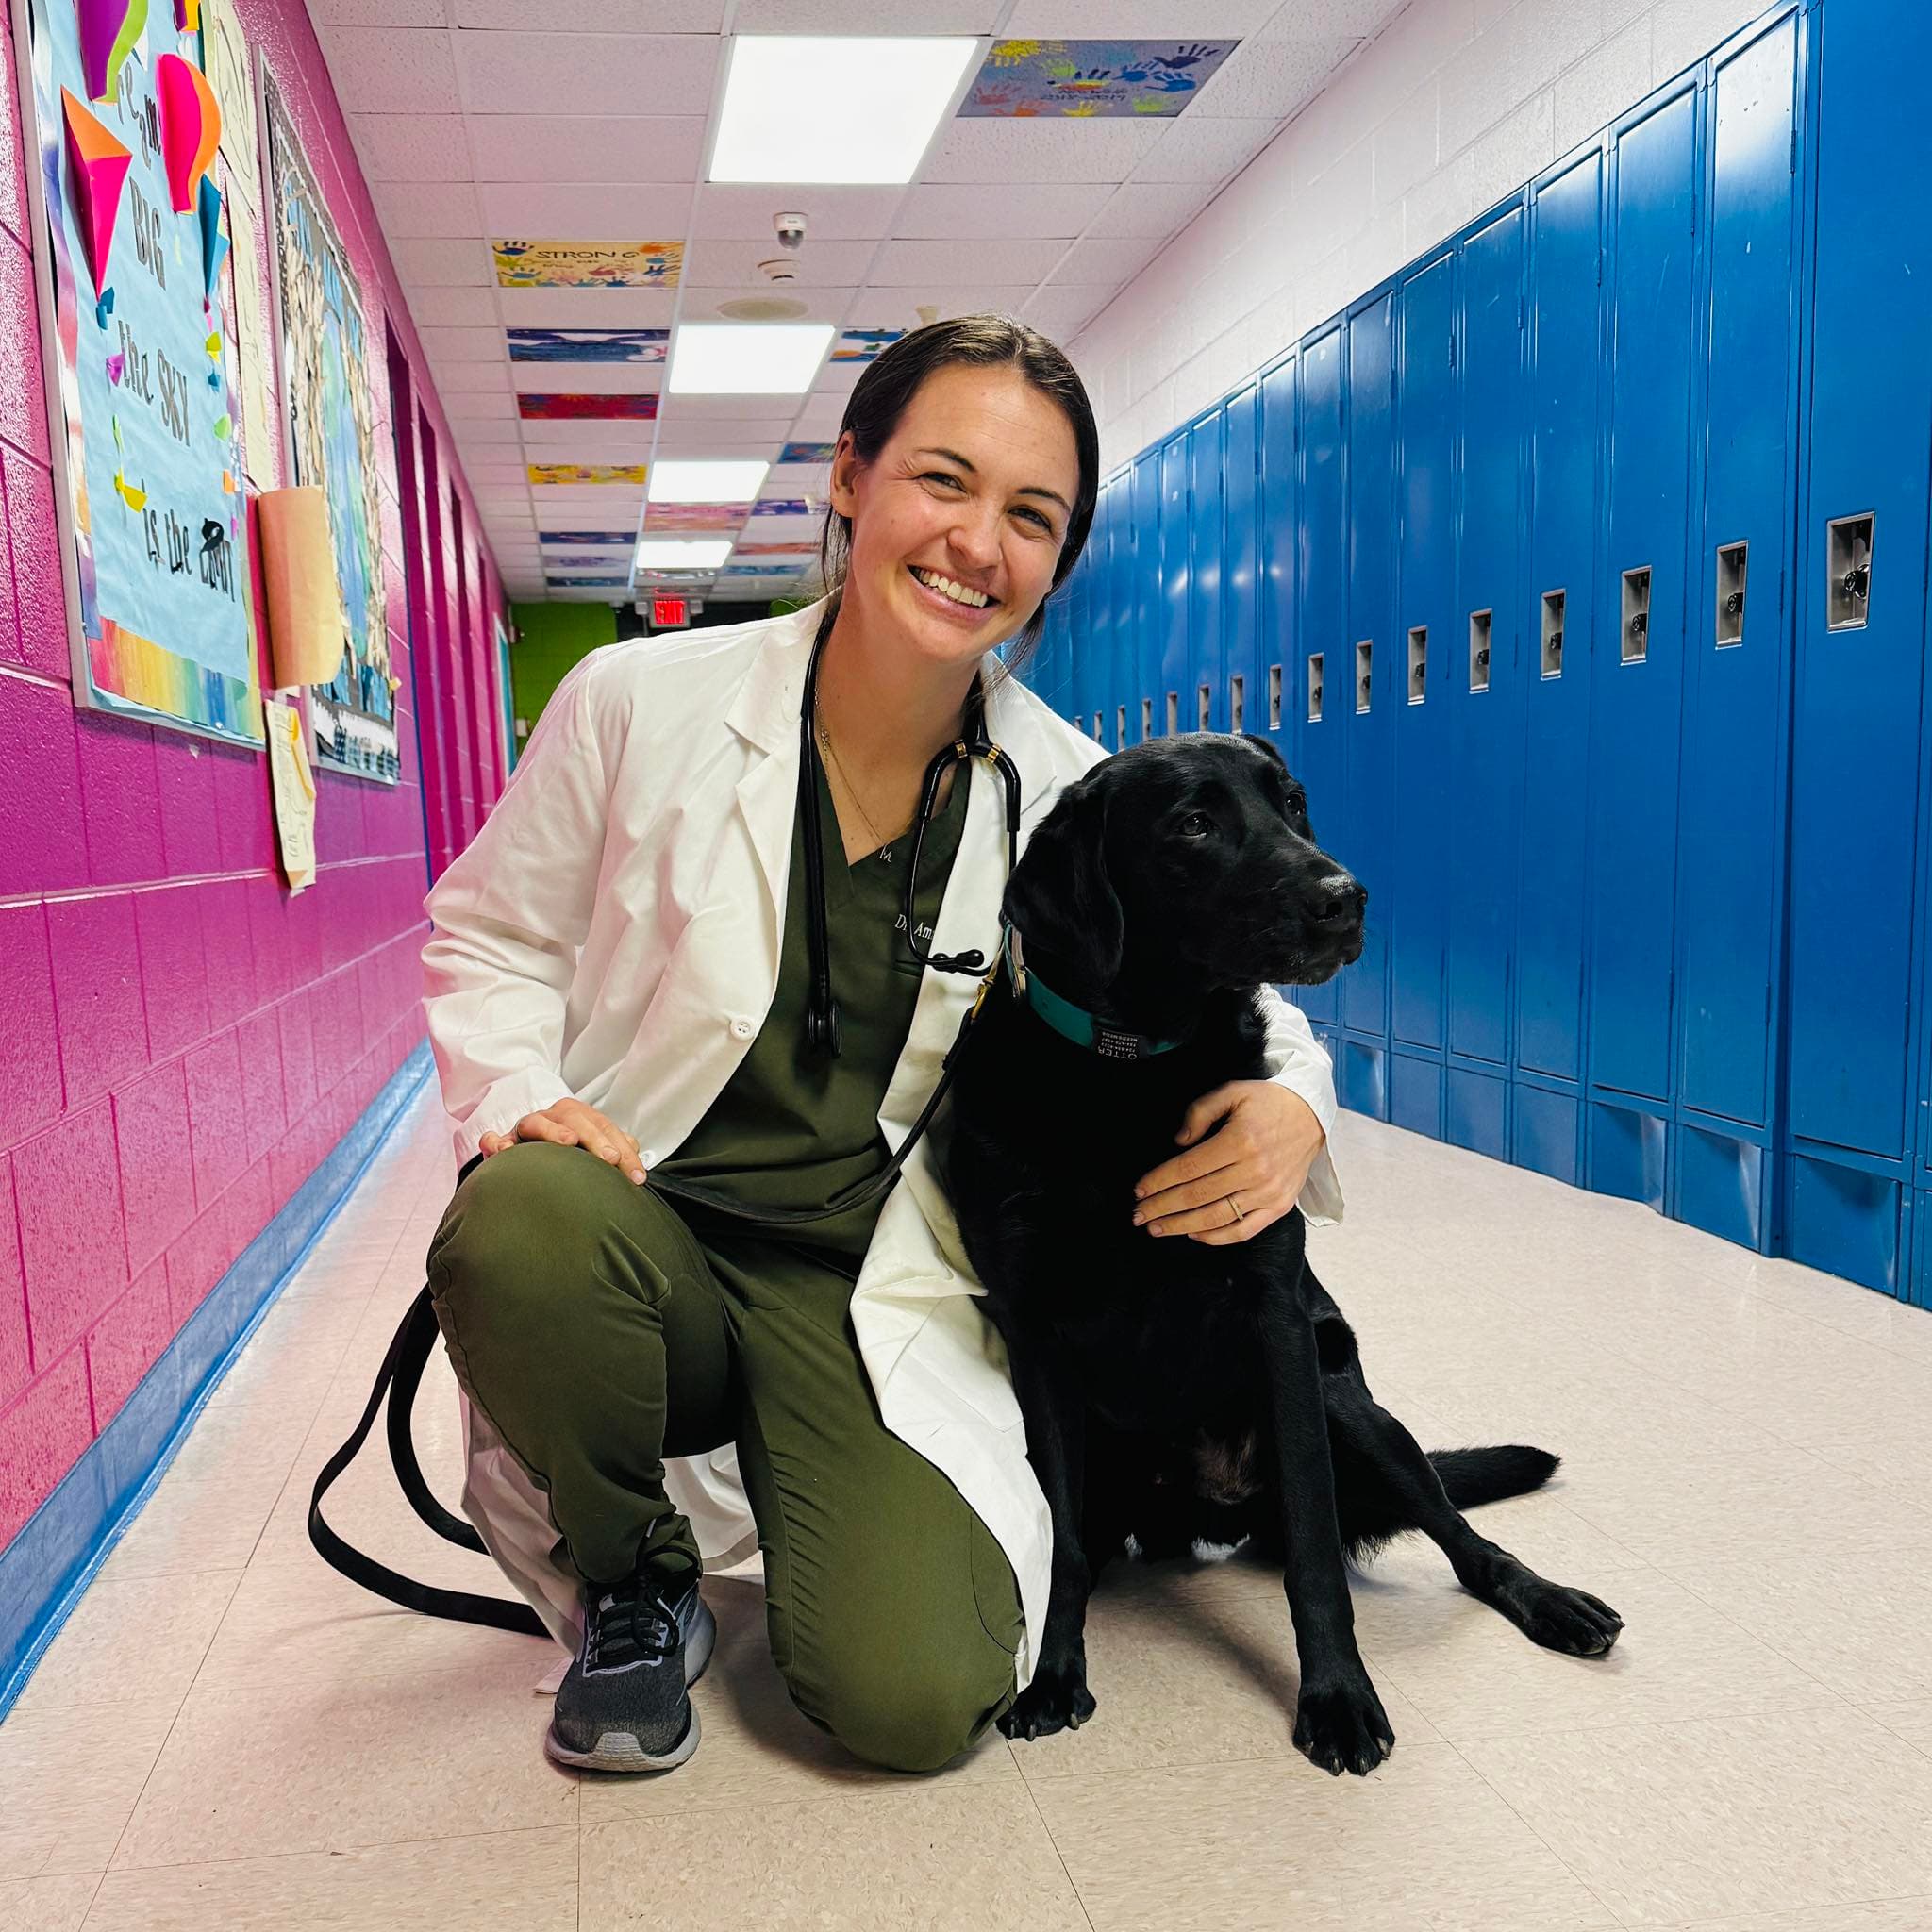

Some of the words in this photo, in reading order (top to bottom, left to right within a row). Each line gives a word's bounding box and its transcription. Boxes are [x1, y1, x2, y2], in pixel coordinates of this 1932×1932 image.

[129, 176, 166, 291] BIG
[535, 251, 640, 259] STRONG
[118, 320, 154, 405] the
[164, 509, 192, 575] the
[1098, 1046, 1138, 1059] OTTER
